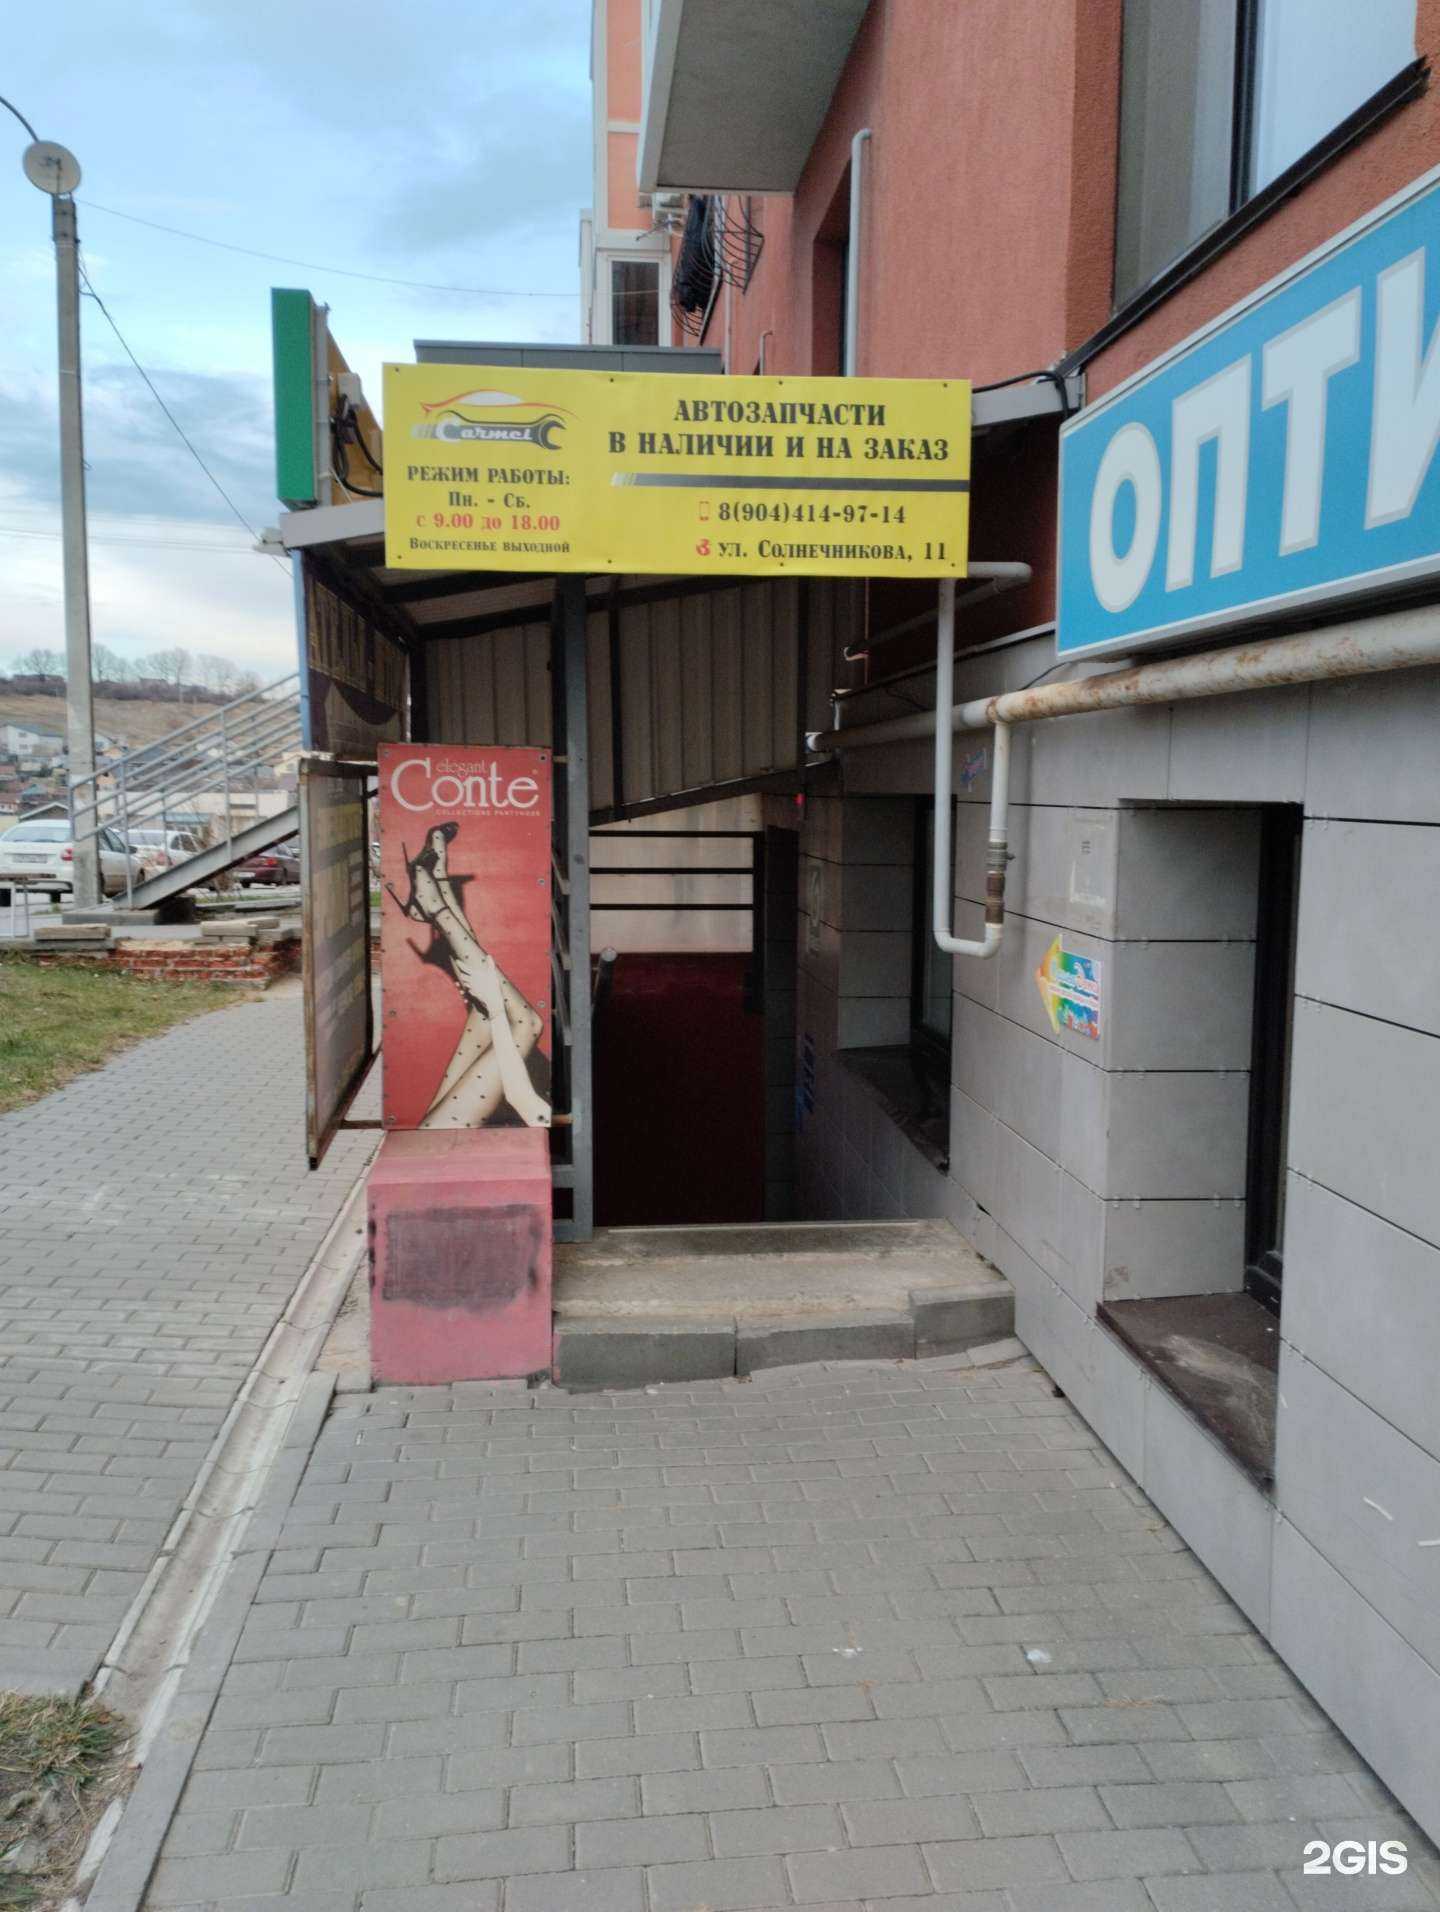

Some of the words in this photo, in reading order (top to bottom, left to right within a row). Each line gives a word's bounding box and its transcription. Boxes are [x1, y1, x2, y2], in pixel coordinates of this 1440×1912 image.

[673, 399, 886, 427] АВТОЗАПЧАСТИ
[608, 431, 626, 453] В
[638, 432, 774, 457] НАЛИЧИИ
[786, 436, 804, 458] И
[816, 437, 853, 460] НА
[863, 437, 949, 461] ЗАКАЗ
[407, 465, 479, 483] РЕЖИМ
[487, 467, 571, 486] РАБОТЫ:
[433, 513, 474, 529] 9.00
[511, 514, 561, 532] 18.00
[718, 502, 906, 524] 8(904)414-97-14
[924, 542, 946, 560] 11
[390, 757, 540, 812] Conte
